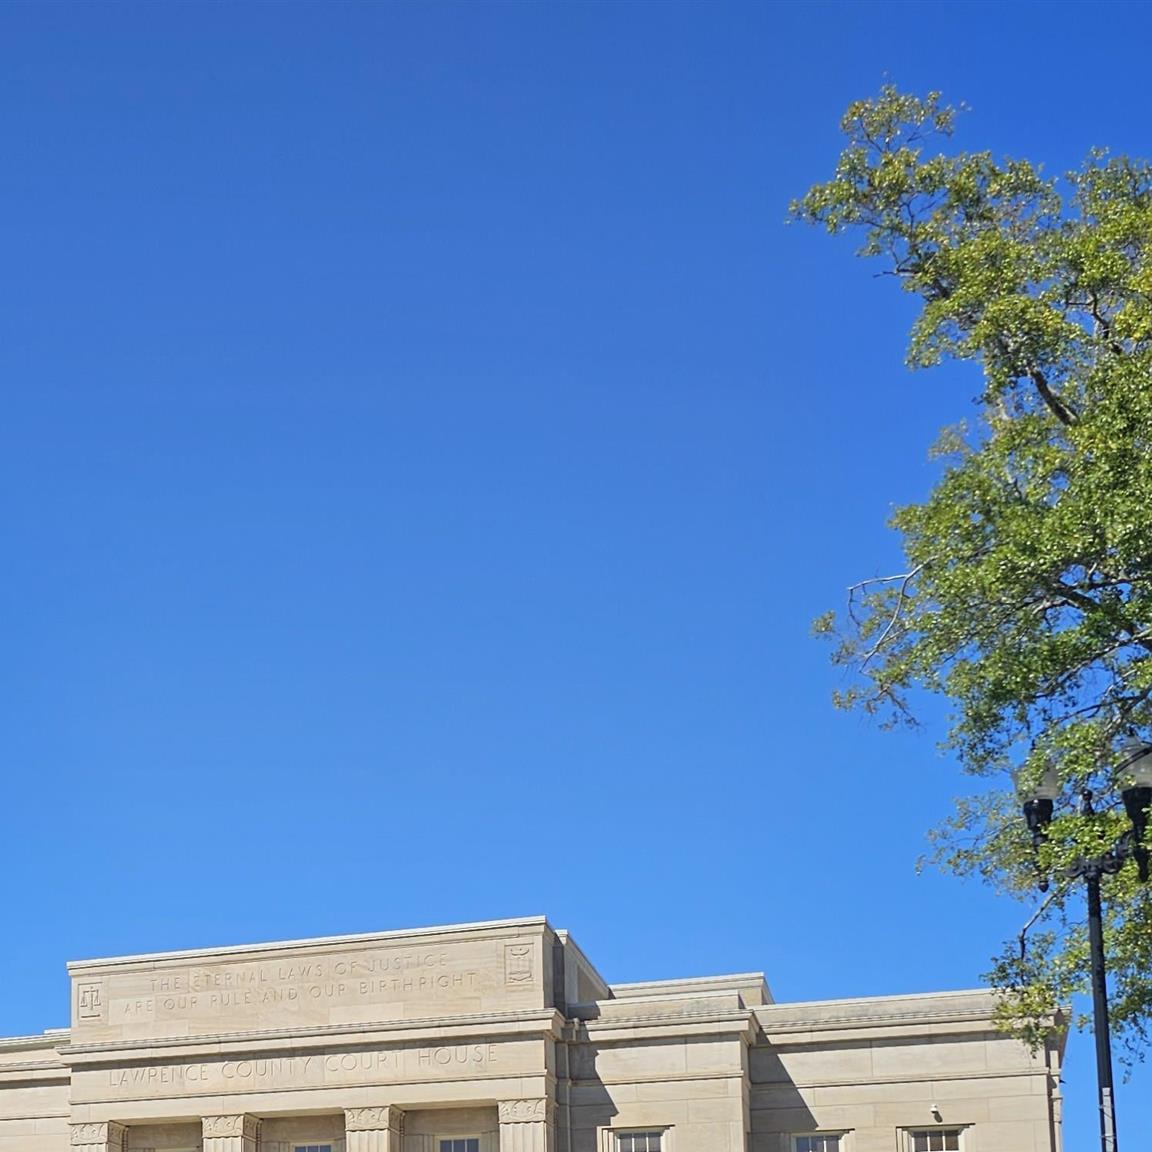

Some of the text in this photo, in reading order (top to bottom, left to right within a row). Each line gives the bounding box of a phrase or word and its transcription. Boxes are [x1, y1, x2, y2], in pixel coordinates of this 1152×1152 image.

[150, 953, 448, 992] THE ETERNAL LAWS OF JUSTICE
[124, 999, 154, 1014] ARE
[163, 996, 199, 1010] OUR
[209, 991, 251, 1007] RULE
[262, 987, 298, 1003] AND
[308, 983, 345, 998] OUR
[108, 1044, 498, 1087] LAWRENCE COUNTY COURT HOUSE
